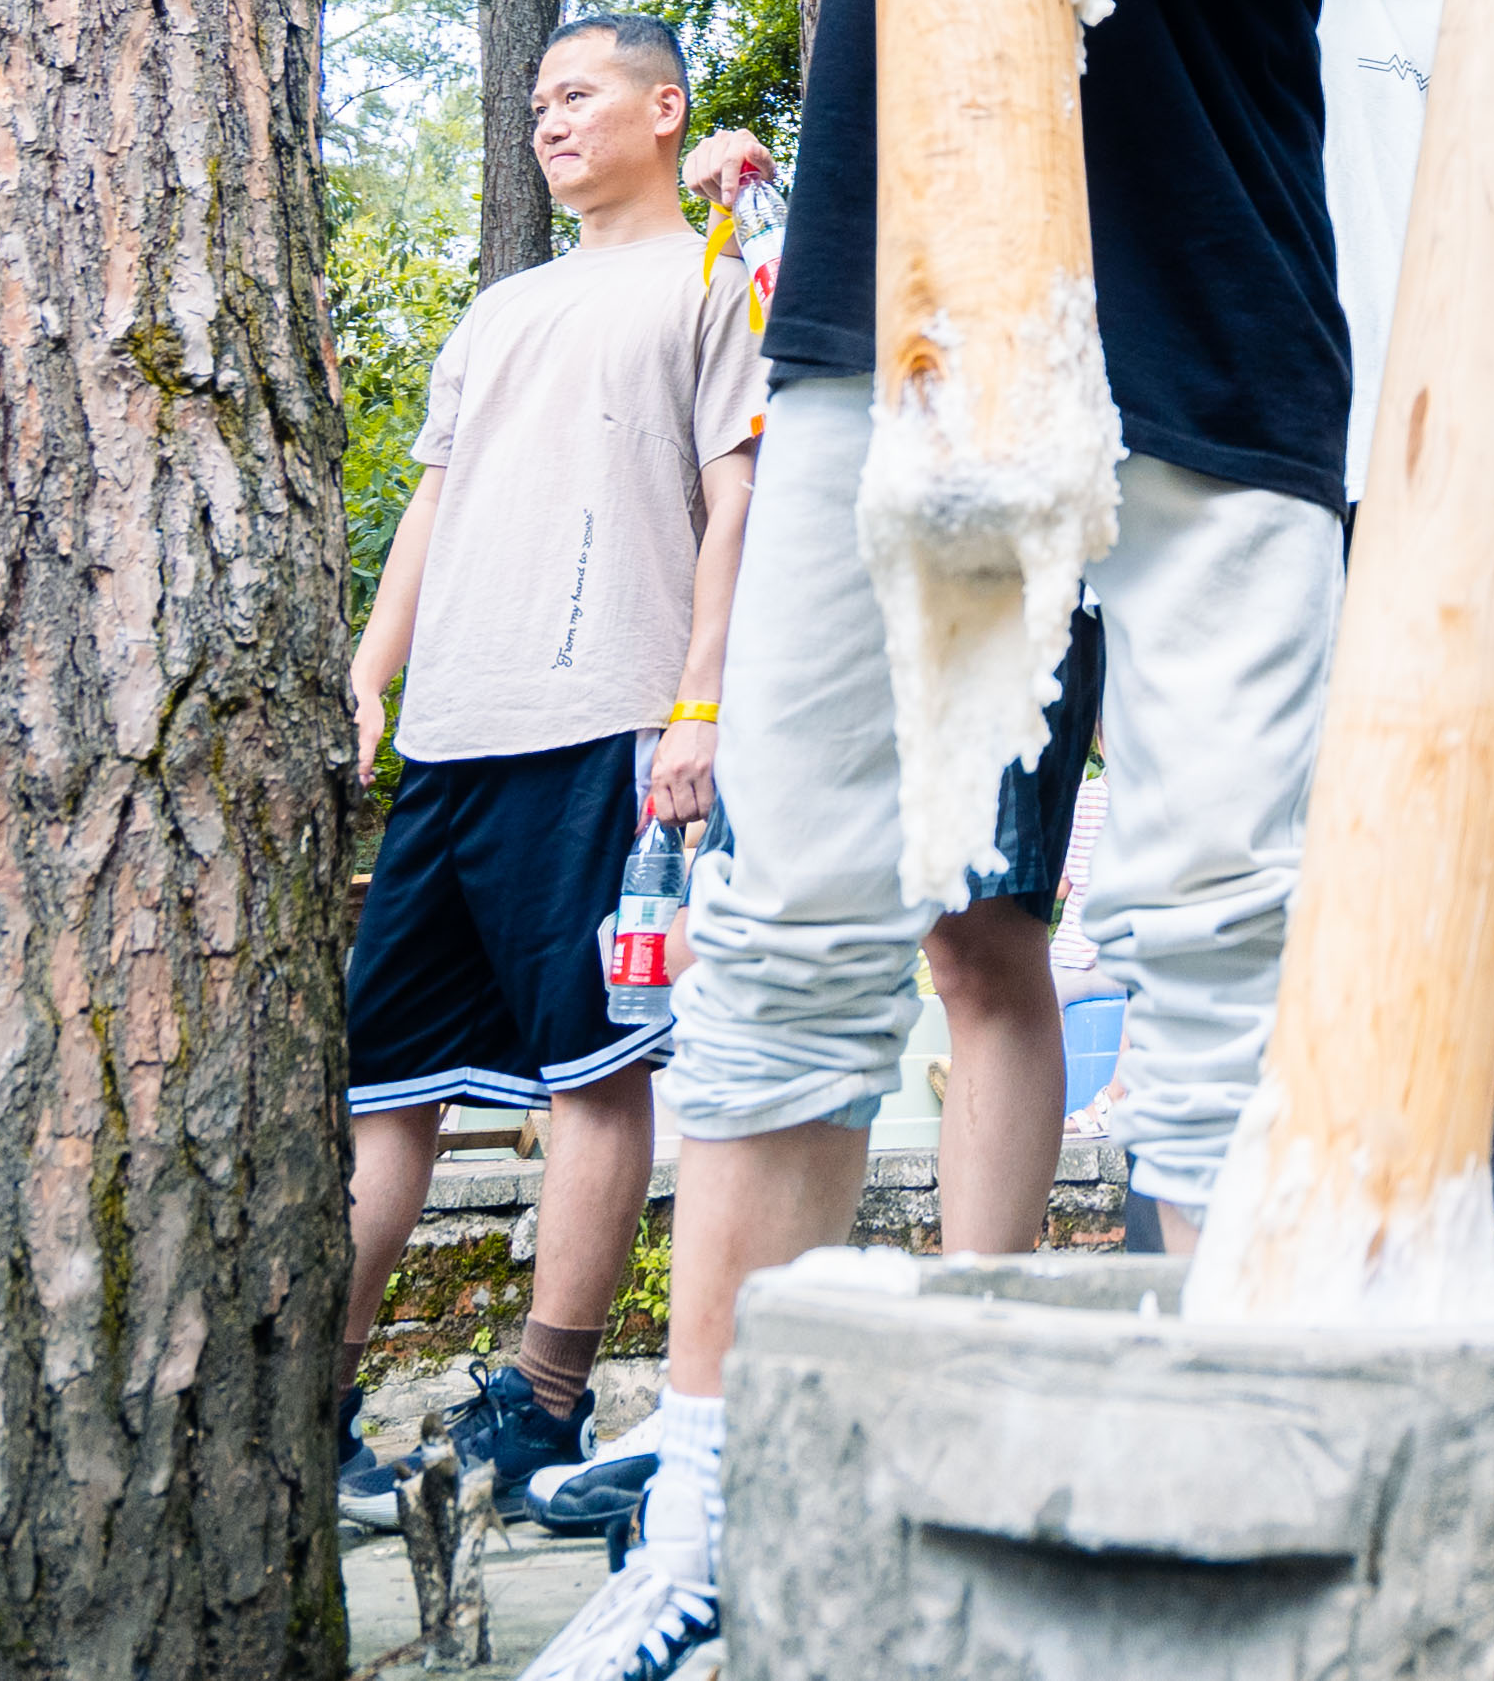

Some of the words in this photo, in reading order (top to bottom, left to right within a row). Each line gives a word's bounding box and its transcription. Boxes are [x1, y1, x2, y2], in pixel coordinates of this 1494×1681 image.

[578, 552, 588, 564] to
[570, 566, 585, 601] hand
[569, 604, 583, 625] my
